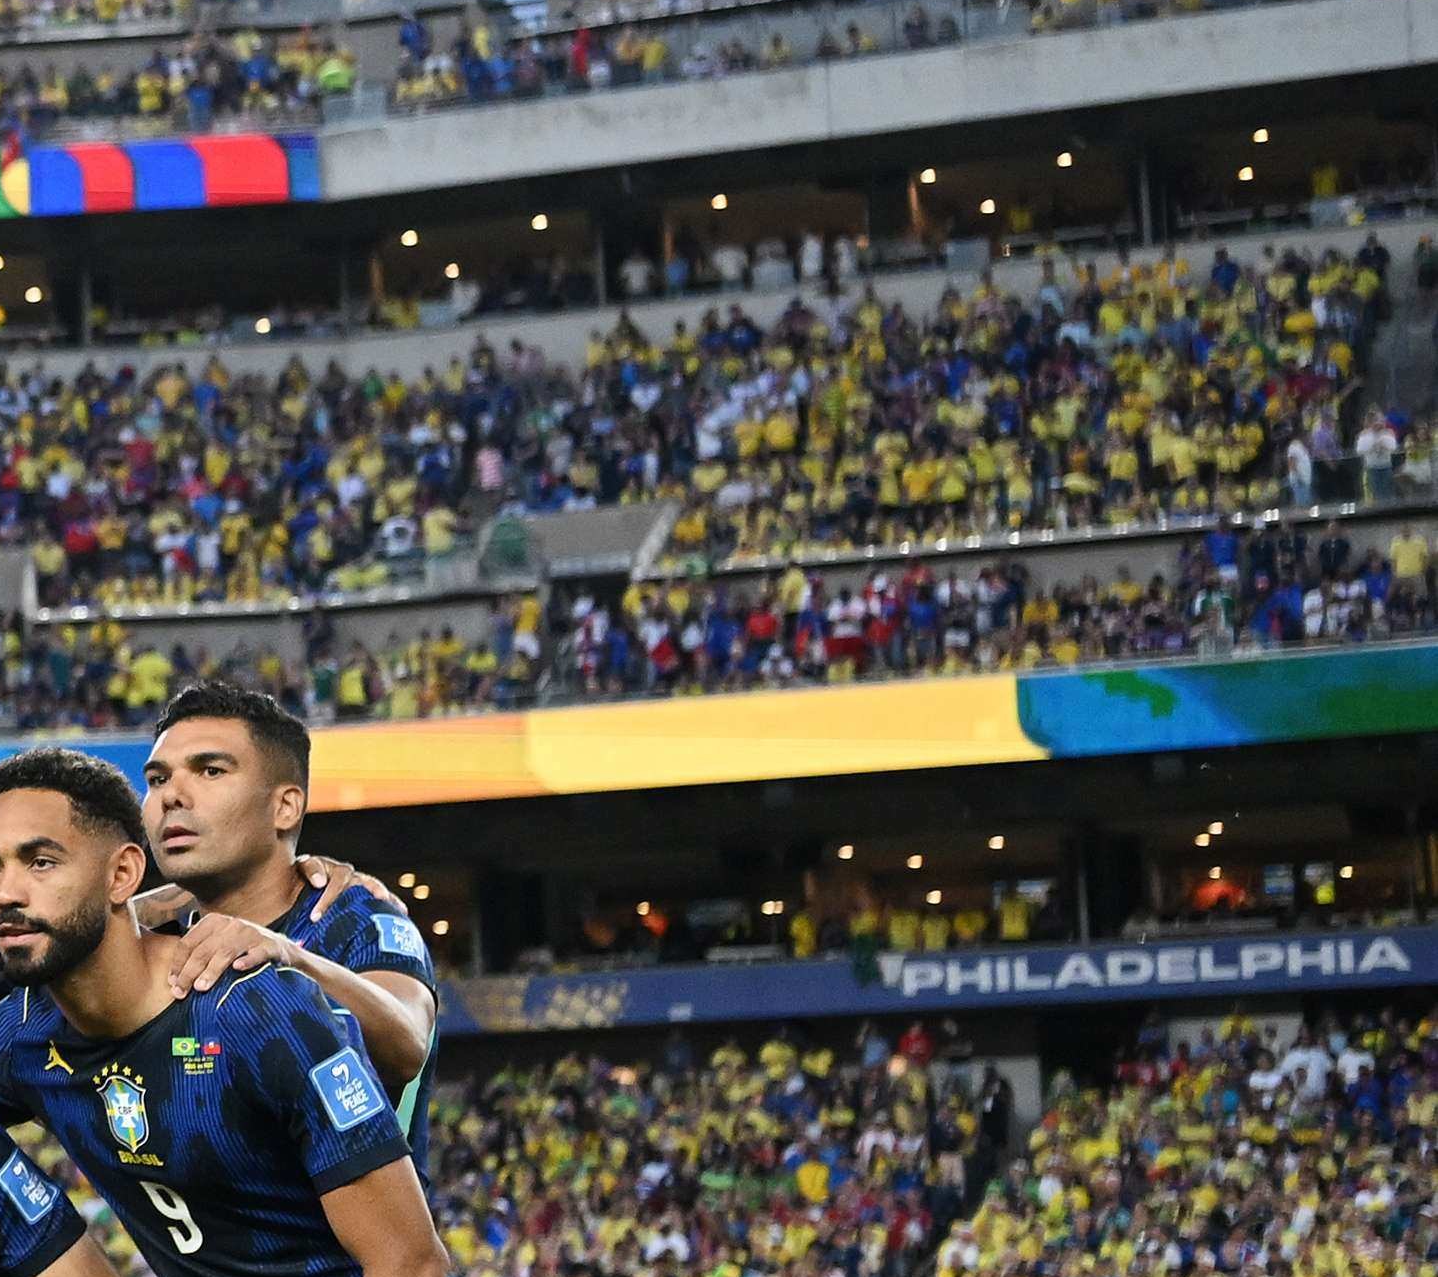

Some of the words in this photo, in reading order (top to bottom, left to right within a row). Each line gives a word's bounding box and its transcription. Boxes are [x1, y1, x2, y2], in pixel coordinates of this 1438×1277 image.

[903, 936, 1410, 997] PHILADELPHIA
[118, 1150, 163, 1167] BRASIL
[140, 1181, 203, 1255] 9
